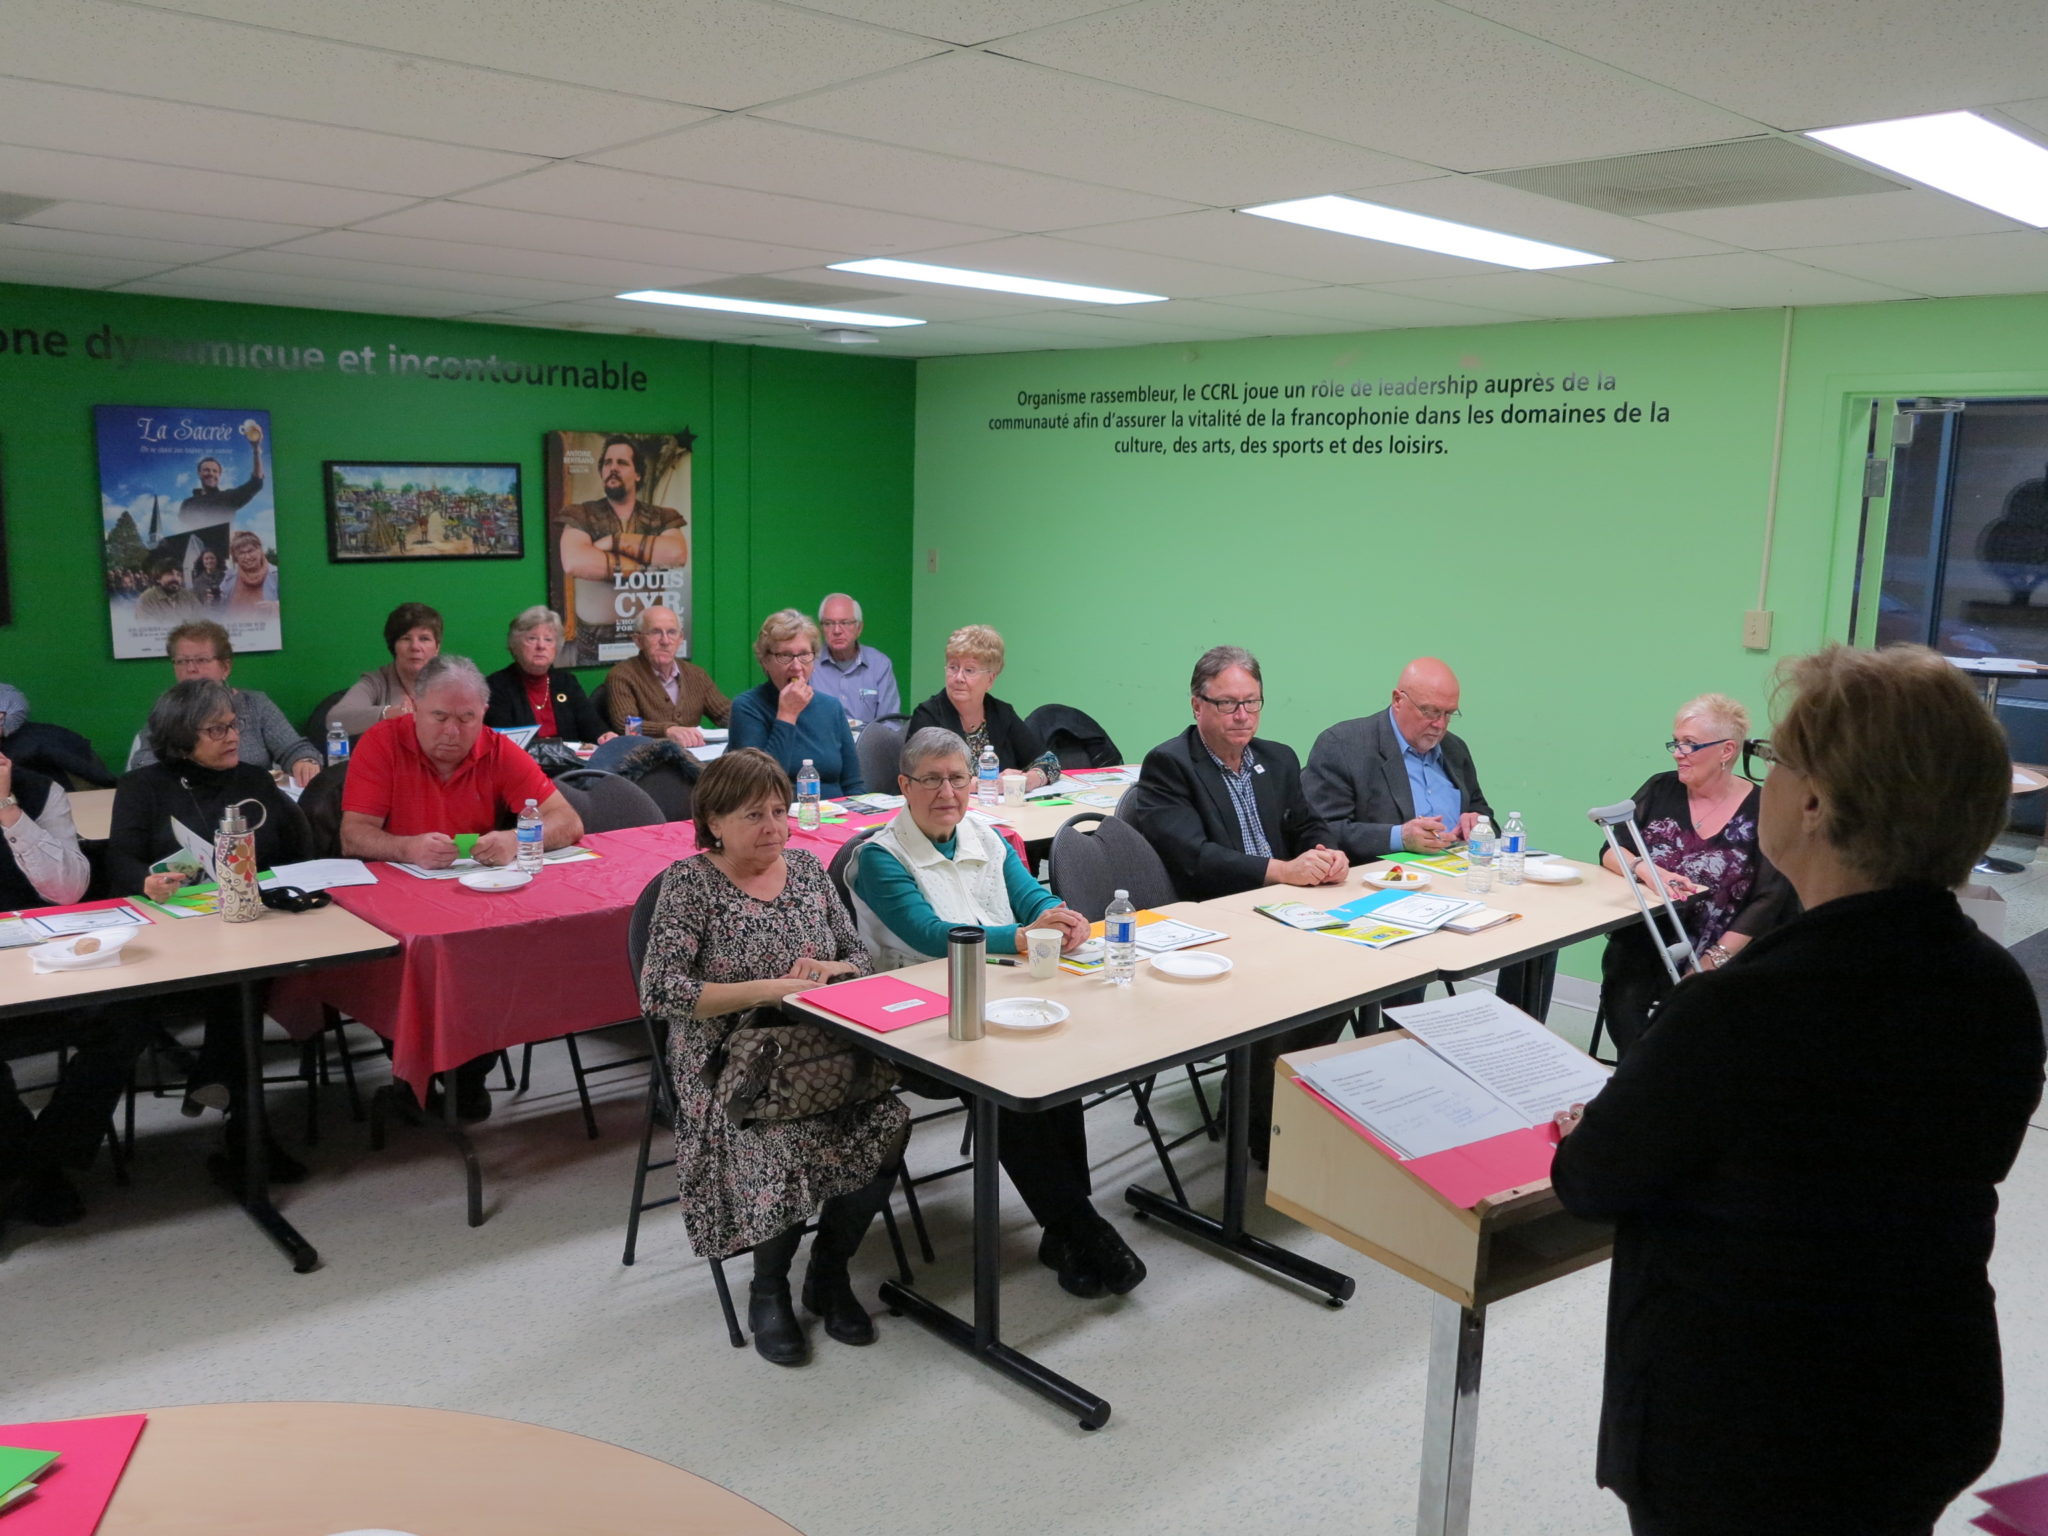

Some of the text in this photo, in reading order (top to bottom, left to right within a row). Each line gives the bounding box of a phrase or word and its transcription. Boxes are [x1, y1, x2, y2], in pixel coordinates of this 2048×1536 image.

[85, 324, 326, 374] dymique
[338, 346, 377, 375] et
[388, 344, 647, 391] incontournable
[1017, 371, 1617, 409] Organisme rassembleur, le CCRL joue un rôle de leadership auprès de la
[137, 417, 233, 442] La Sacrée
[988, 401, 1671, 430] communauté afin d'assurer la vitalité de la francophonie dans les domaines de la
[1114, 434, 1449, 458] culture, des arts, des sports et des loisirs.
[613, 570, 685, 590] LOUIS
[614, 590, 684, 618] CYR
